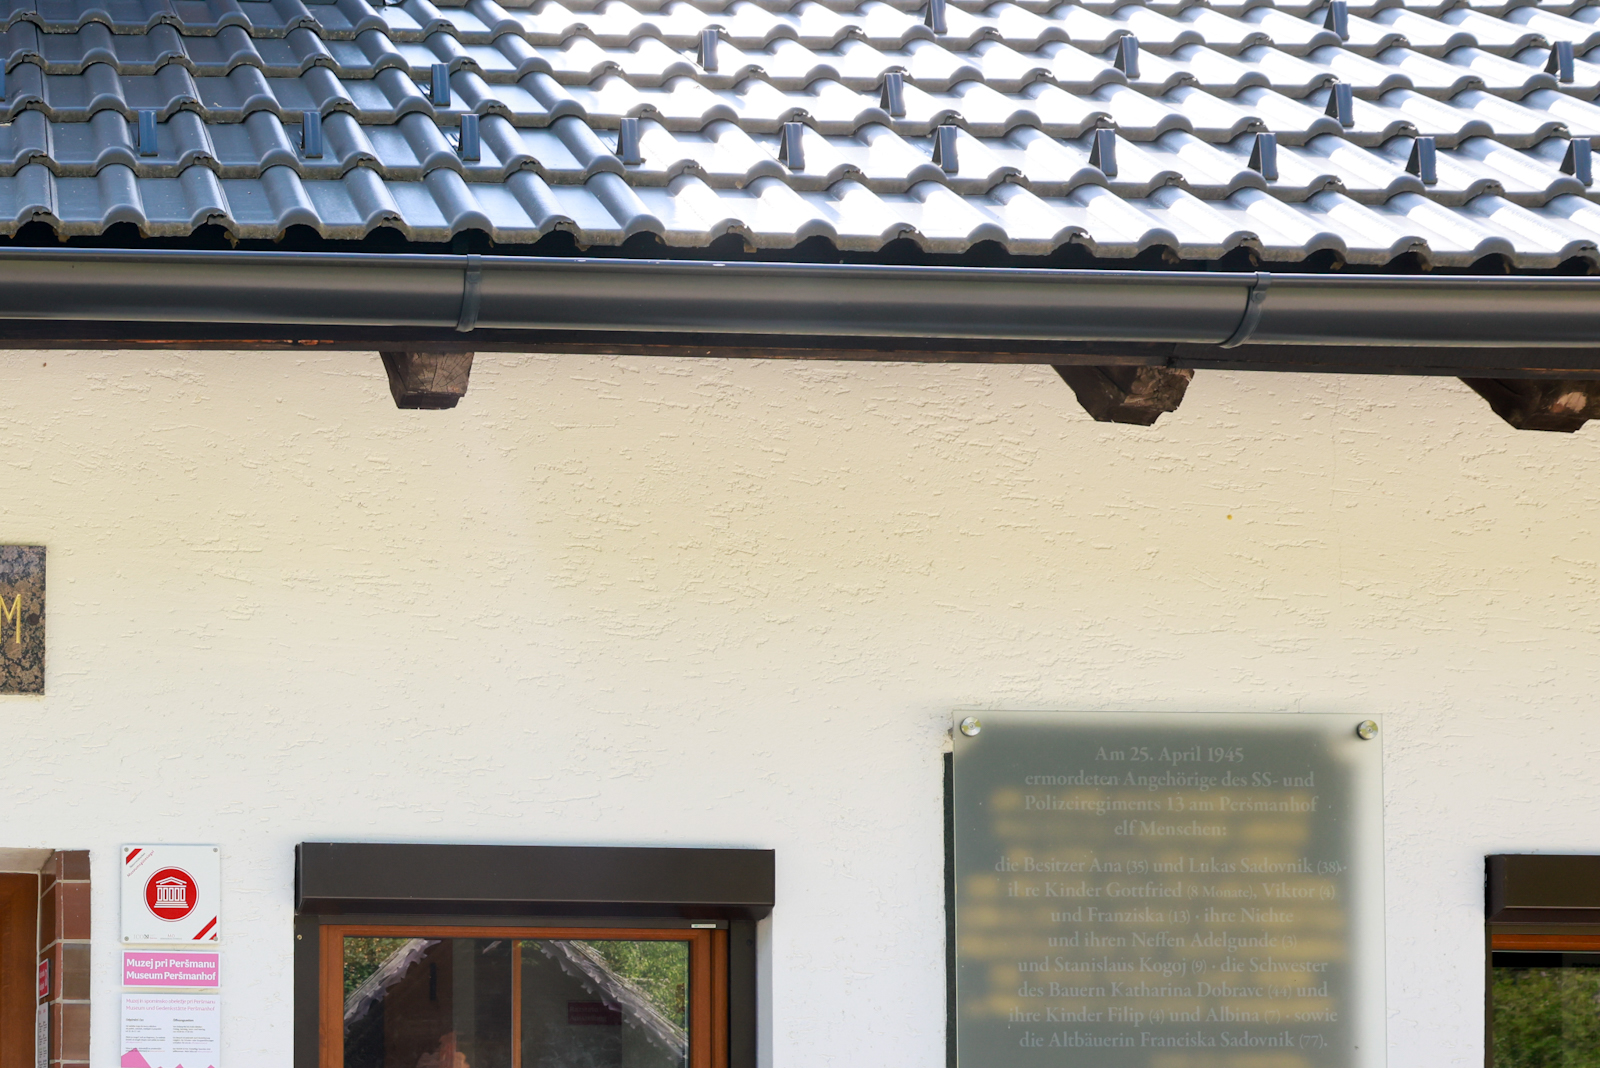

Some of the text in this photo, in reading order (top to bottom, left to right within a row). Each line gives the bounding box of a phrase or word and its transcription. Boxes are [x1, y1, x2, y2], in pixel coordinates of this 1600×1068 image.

[1095, 746, 1244, 765] Am 25. April 1945
[1025, 770, 1314, 789] ermordeten Angehörige des SS- und
[1024, 795, 1319, 814] Polizeiregiments 13 am Peršmanhof
[1114, 820, 1228, 836] elf Menschen:
[995, 857, 1020, 873] die
[1023, 857, 1086, 873] Besitzer
[1089, 857, 1122, 873] Ana
[1153, 857, 1184, 873] und
[1189, 857, 1236, 873] Lukas
[1240, 857, 1312, 873] Sadovnik
[1050, 907, 1083, 923] und
[1087, 907, 1165, 923] Franziska
[1204, 907, 1236, 923] ihre
[1240, 907, 1294, 923] Nichte
[1048, 932, 1080, 947] und
[1085, 932, 1126, 947] ihren
[1131, 932, 1186, 947] Neffen
[1190, 932, 1278, 950] Adelgunde
[126, 958, 216, 969] Muzej pri Peršmanu
[1017, 957, 1049, 972] und
[1054, 957, 1135, 972] Stanislaus
[1139, 957, 1186, 975] Kogoj
[1221, 957, 1244, 972] die
[1250, 957, 1328, 972] Schwester
[126, 971, 216, 981] Museum Peršmanhof
[1008, 1006, 1042, 1022] ihre
[1046, 1006, 1103, 1022] Kinder
[1107, 1006, 1144, 1025] Filip
[1169, 1006, 1200, 1022] und
[1205, 1006, 1260, 1022] Albina
[1294, 1006, 1338, 1022] sowie
[1019, 1031, 1044, 1047] die
[1048, 1031, 1135, 1047] Altbäuerin
[1141, 1031, 1216, 1047] Franciska
[1221, 1031, 1294, 1047] Sadovnik
